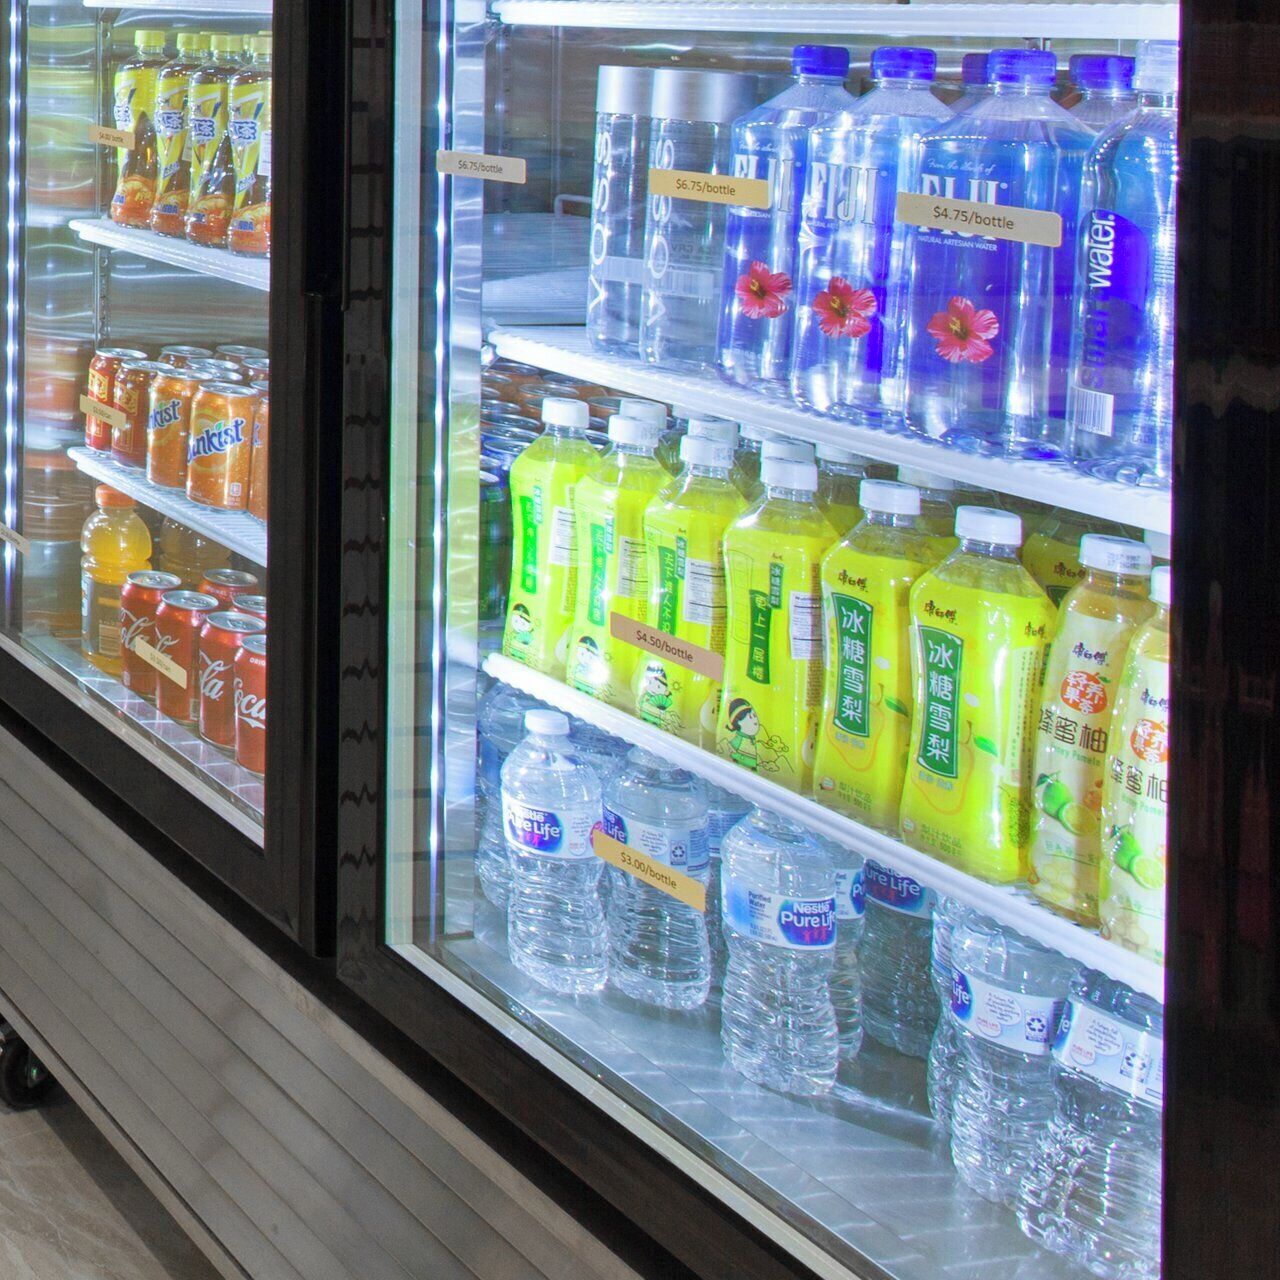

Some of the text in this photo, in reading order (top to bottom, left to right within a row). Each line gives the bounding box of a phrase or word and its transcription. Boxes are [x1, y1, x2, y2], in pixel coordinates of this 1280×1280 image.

[457, 160, 504, 175] $6.75/bottle
[676, 178, 736, 197] $6.75/bottle
[933, 206, 1015, 231] $4.75/bottle
[918, 236, 998, 251] NATURAL ARTESIAN WATER
[635, 629, 694, 663] $4.50/bottle
[840, 607, 865, 724] 冰糖雪梨
[927, 638, 954, 763] 冰糖雪梨
[620, 851, 678, 891] $3.00/bottle
[891, 877, 920, 897] Life
[781, 911, 820, 928] Pure
